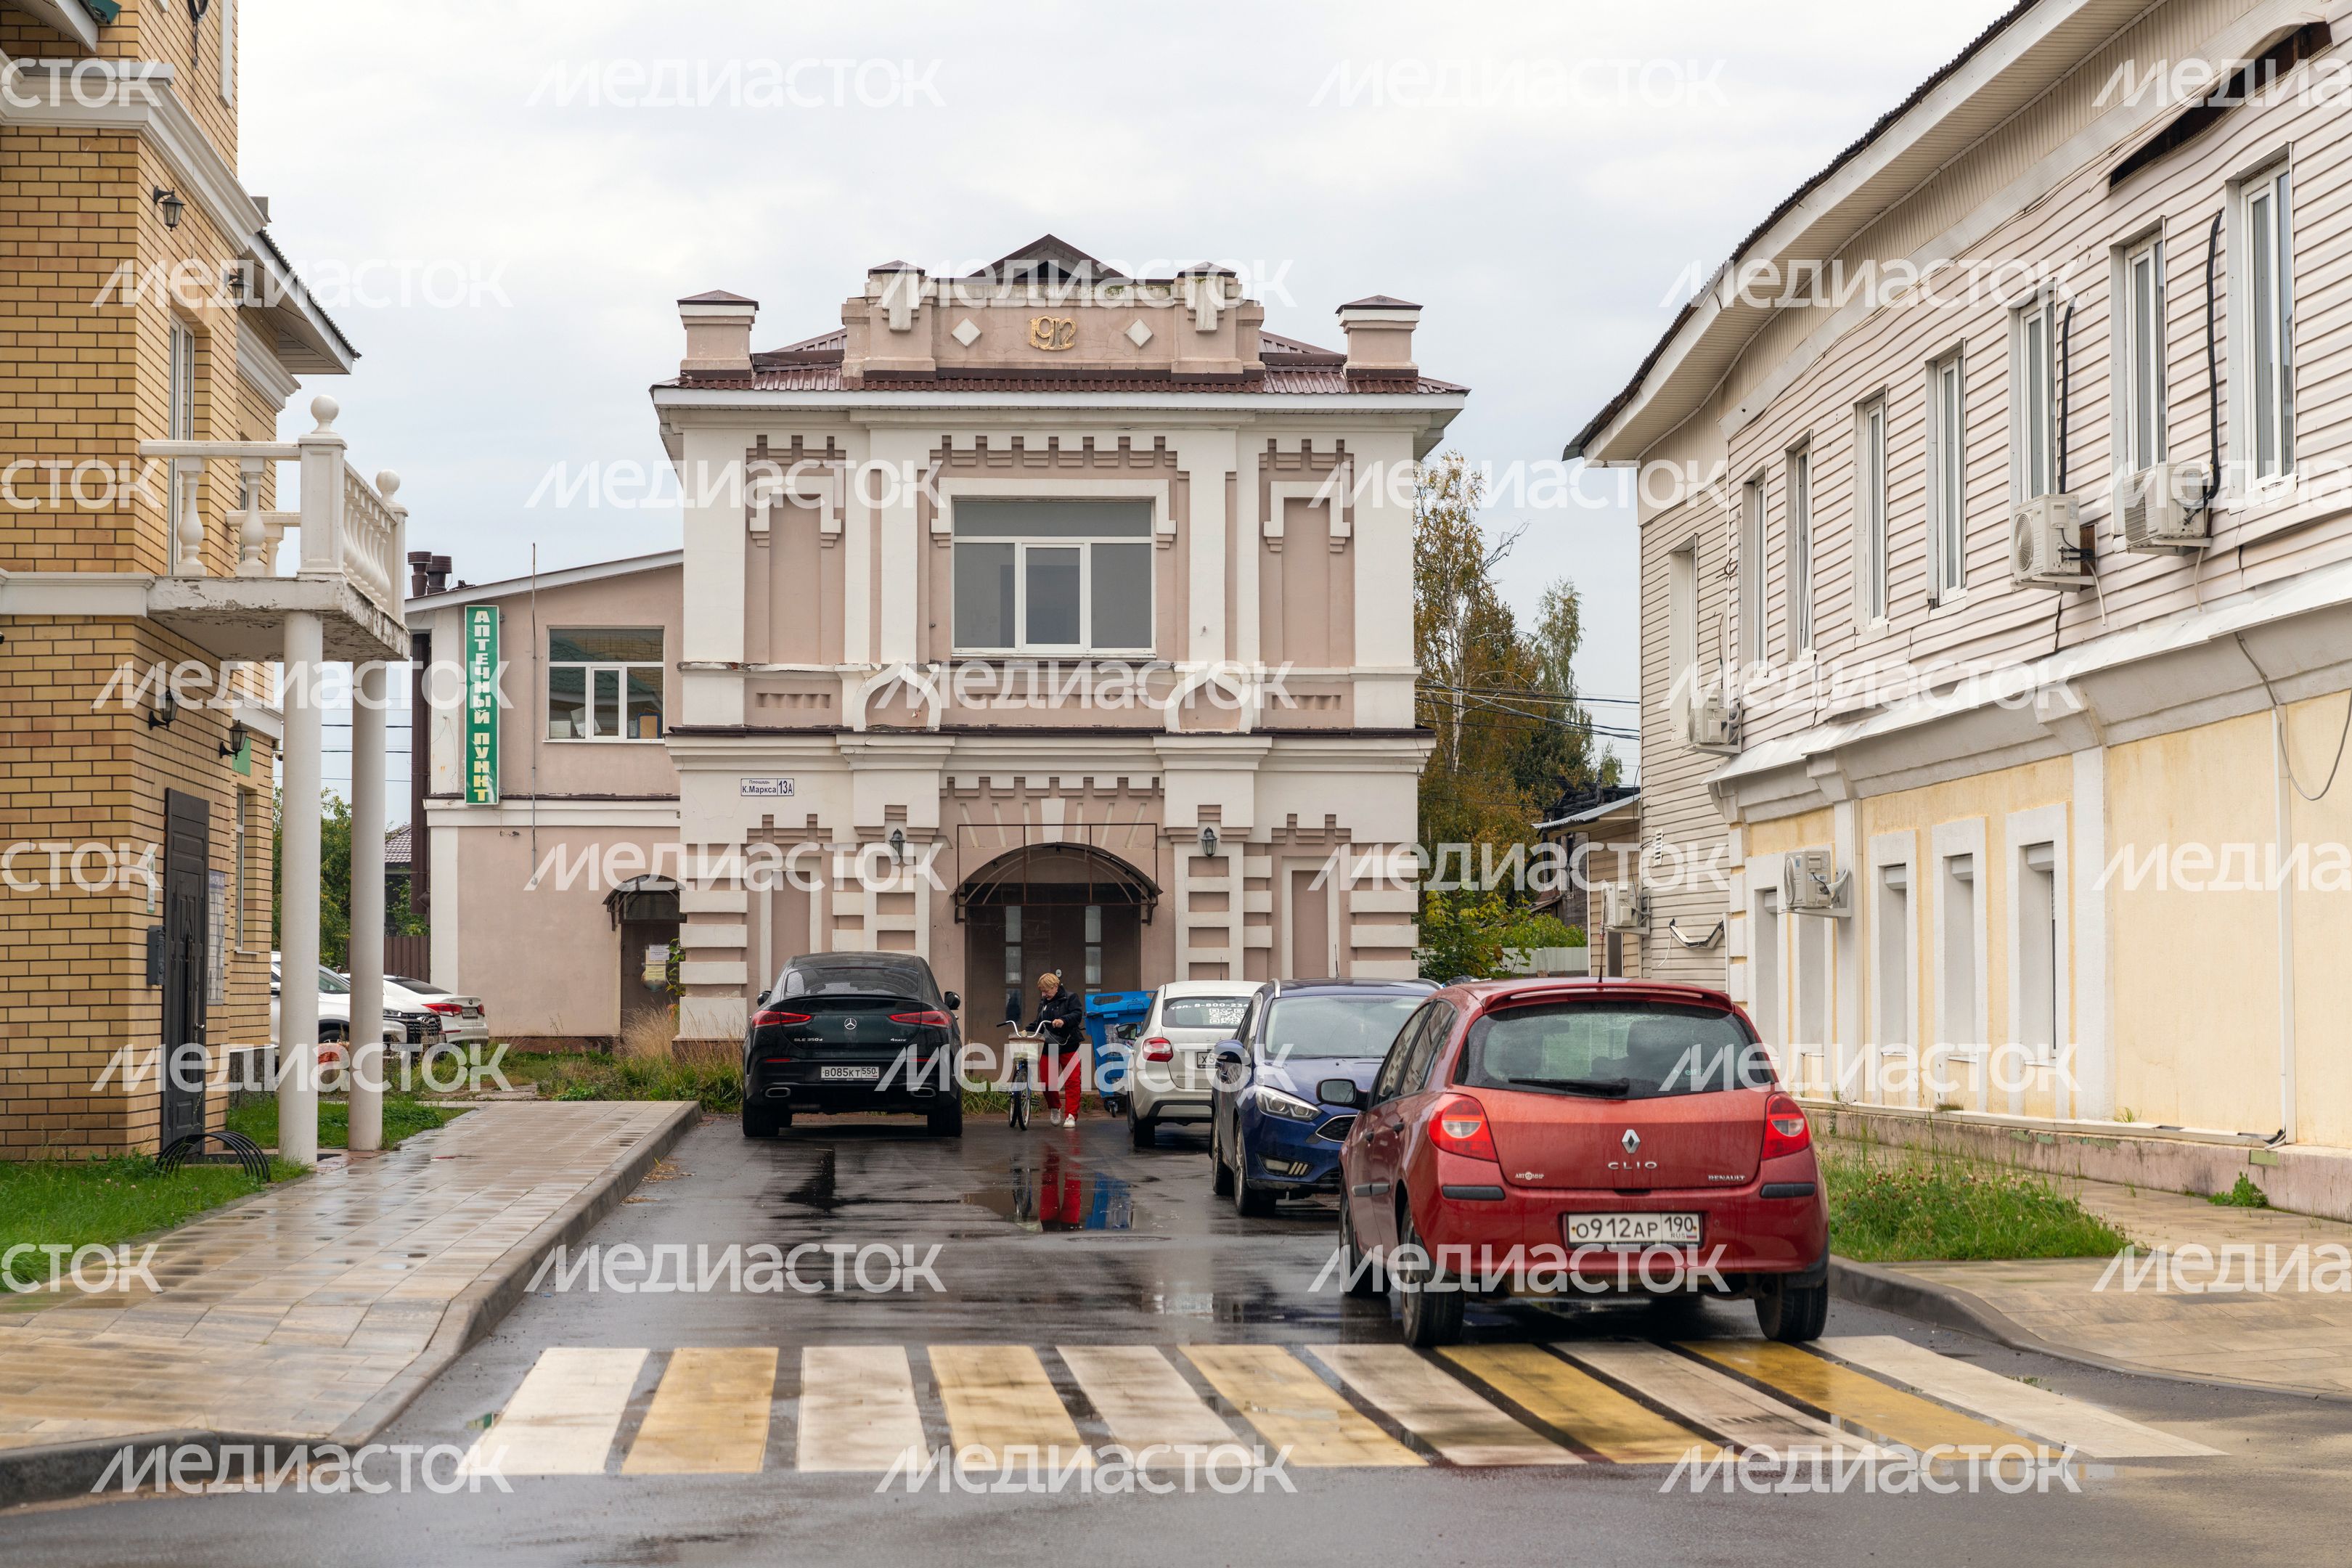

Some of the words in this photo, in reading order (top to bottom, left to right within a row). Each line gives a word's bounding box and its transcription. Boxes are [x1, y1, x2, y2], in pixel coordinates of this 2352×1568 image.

[1029, 315, 1077, 351] 1912
[473, 611, 491, 724] АПТЕЧНЫЙ
[473, 732, 490, 801] ПУНКТ
[825, 1067, 860, 1077] В085КТ
[1608, 1161, 1657, 1170] CLIO
[1575, 1217, 1658, 1238] О912АР
[1665, 1216, 1694, 1232] 190
